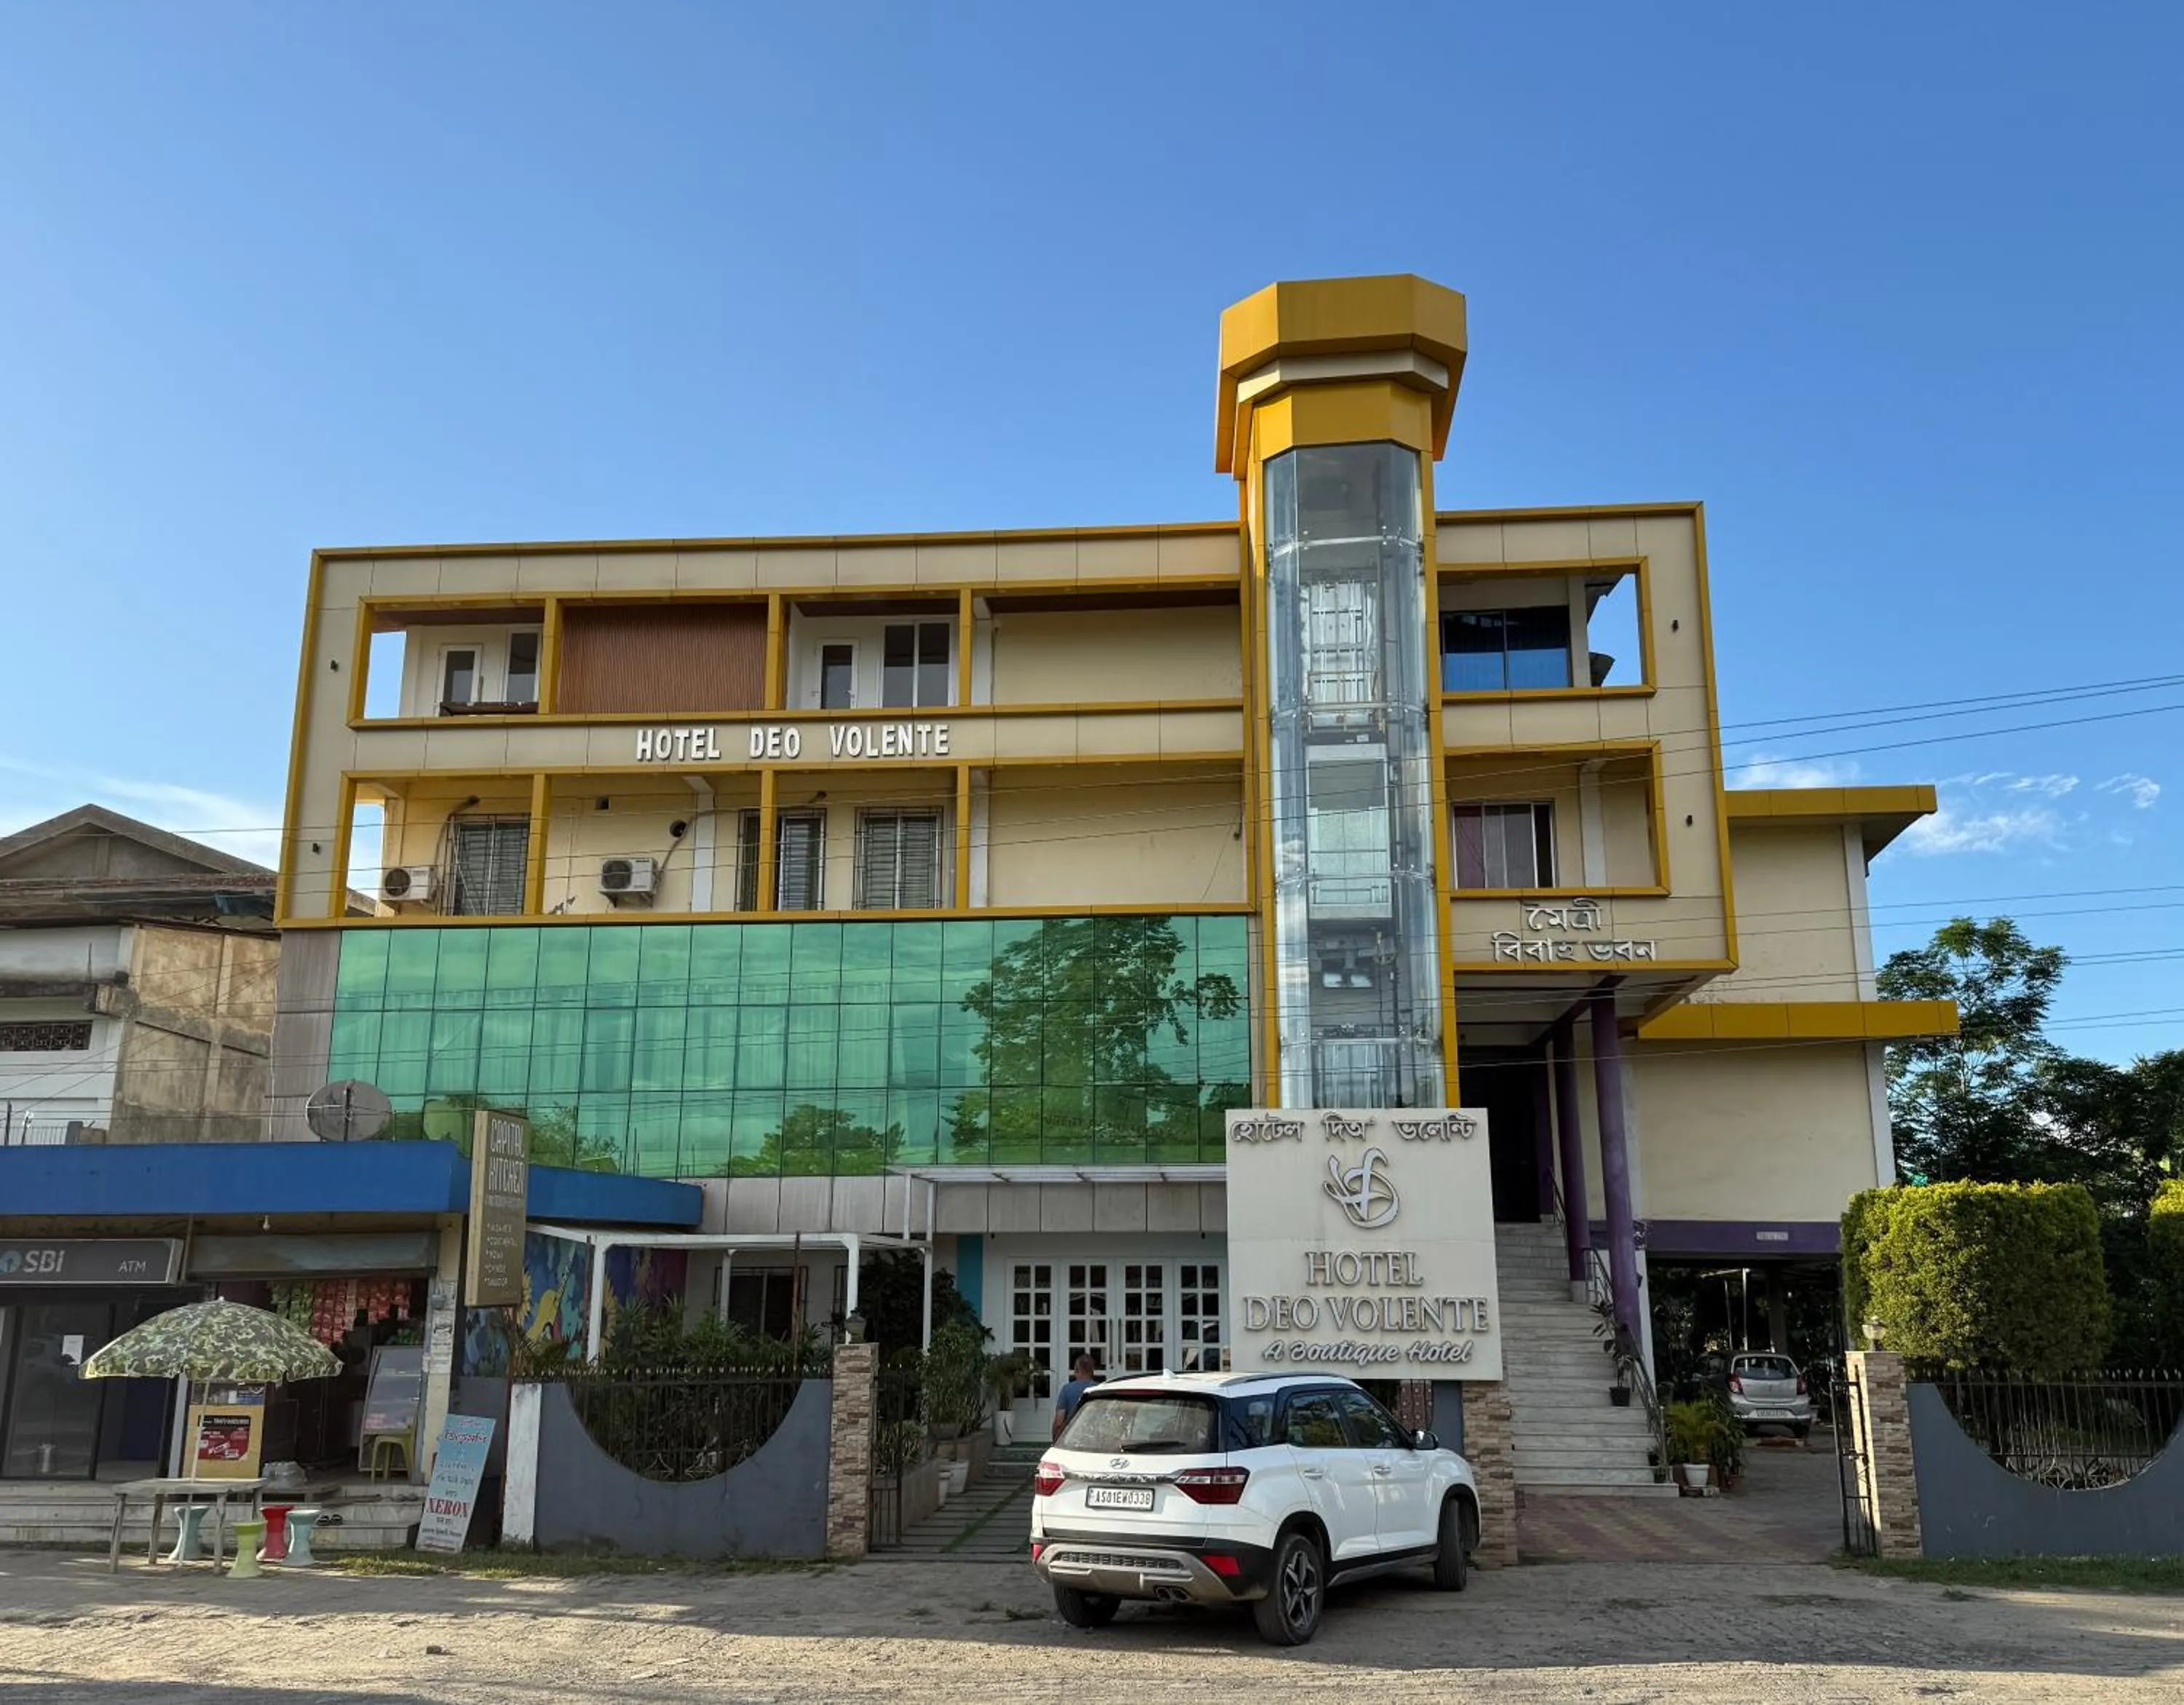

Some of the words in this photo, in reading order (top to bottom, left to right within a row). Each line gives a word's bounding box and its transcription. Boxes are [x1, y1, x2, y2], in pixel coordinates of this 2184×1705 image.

[636, 727, 721, 761] HOTEL
[749, 727, 801, 759] DEO
[828, 724, 949, 758] VOLENTE
[1491, 931, 1580, 962] বিবাহ
[1583, 940, 1657, 962] ভবন
[491, 1118, 524, 1158] CAPITAL
[1230, 1112, 1305, 1142] হোটেল
[23, 1250, 66, 1273] SBI
[118, 1260, 146, 1273] ATM
[1305, 1251, 1423, 1286] HOTEL
[1243, 1296, 1320, 1332] DEO
[1328, 1297, 1489, 1332] VOLENTE
[1263, 1339, 1284, 1361] A
[1290, 1339, 1399, 1368] Boutique
[1407, 1339, 1474, 1363] Hotel
[427, 1498, 470, 1518] XEROX
